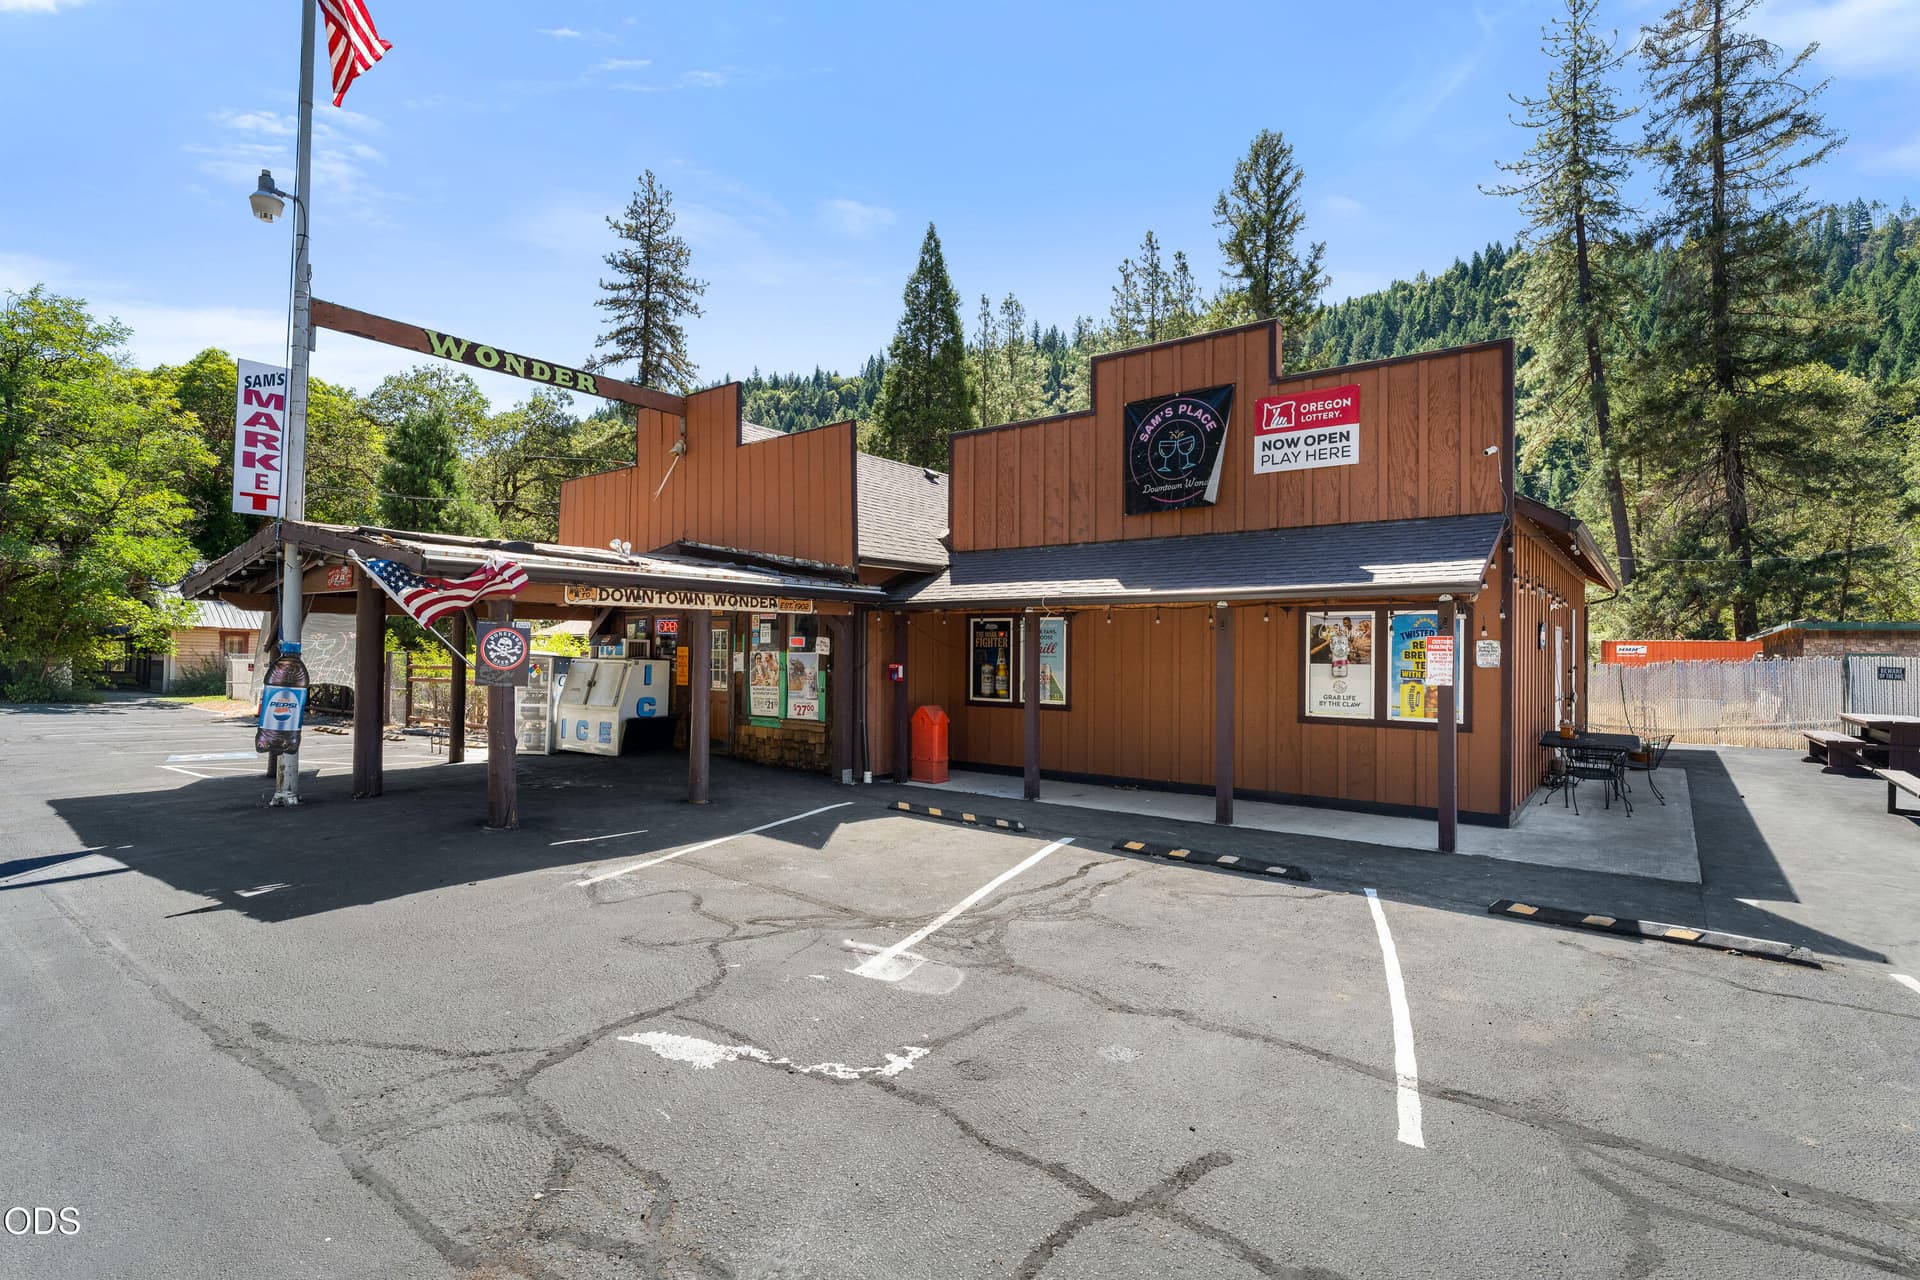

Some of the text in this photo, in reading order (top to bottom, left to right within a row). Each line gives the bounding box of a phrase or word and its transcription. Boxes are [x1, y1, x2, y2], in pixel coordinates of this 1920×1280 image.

[424, 329, 597, 394] WONDER
[244, 372, 285, 388] SAM'S
[1300, 397, 1352, 413] OREGON
[1139, 403, 1217, 442] SAM'S PLACE
[240, 387, 285, 511] MARKET
[1261, 430, 1351, 452] NOW OPEN
[1261, 445, 1351, 467] PLAY HERE
[1142, 483, 1183, 494] Downtown
[598, 588, 706, 606] DOWNTOWN
[713, 594, 778, 609] WONDER
[975, 638, 1009, 648] FIGHTER
[1400, 629, 1435, 641] TWISTED
[1412, 641, 1426, 650] RE
[1404, 651, 1426, 660] BRE
[270, 701, 297, 709] PEPSI
[561, 718, 613, 744] ICE
